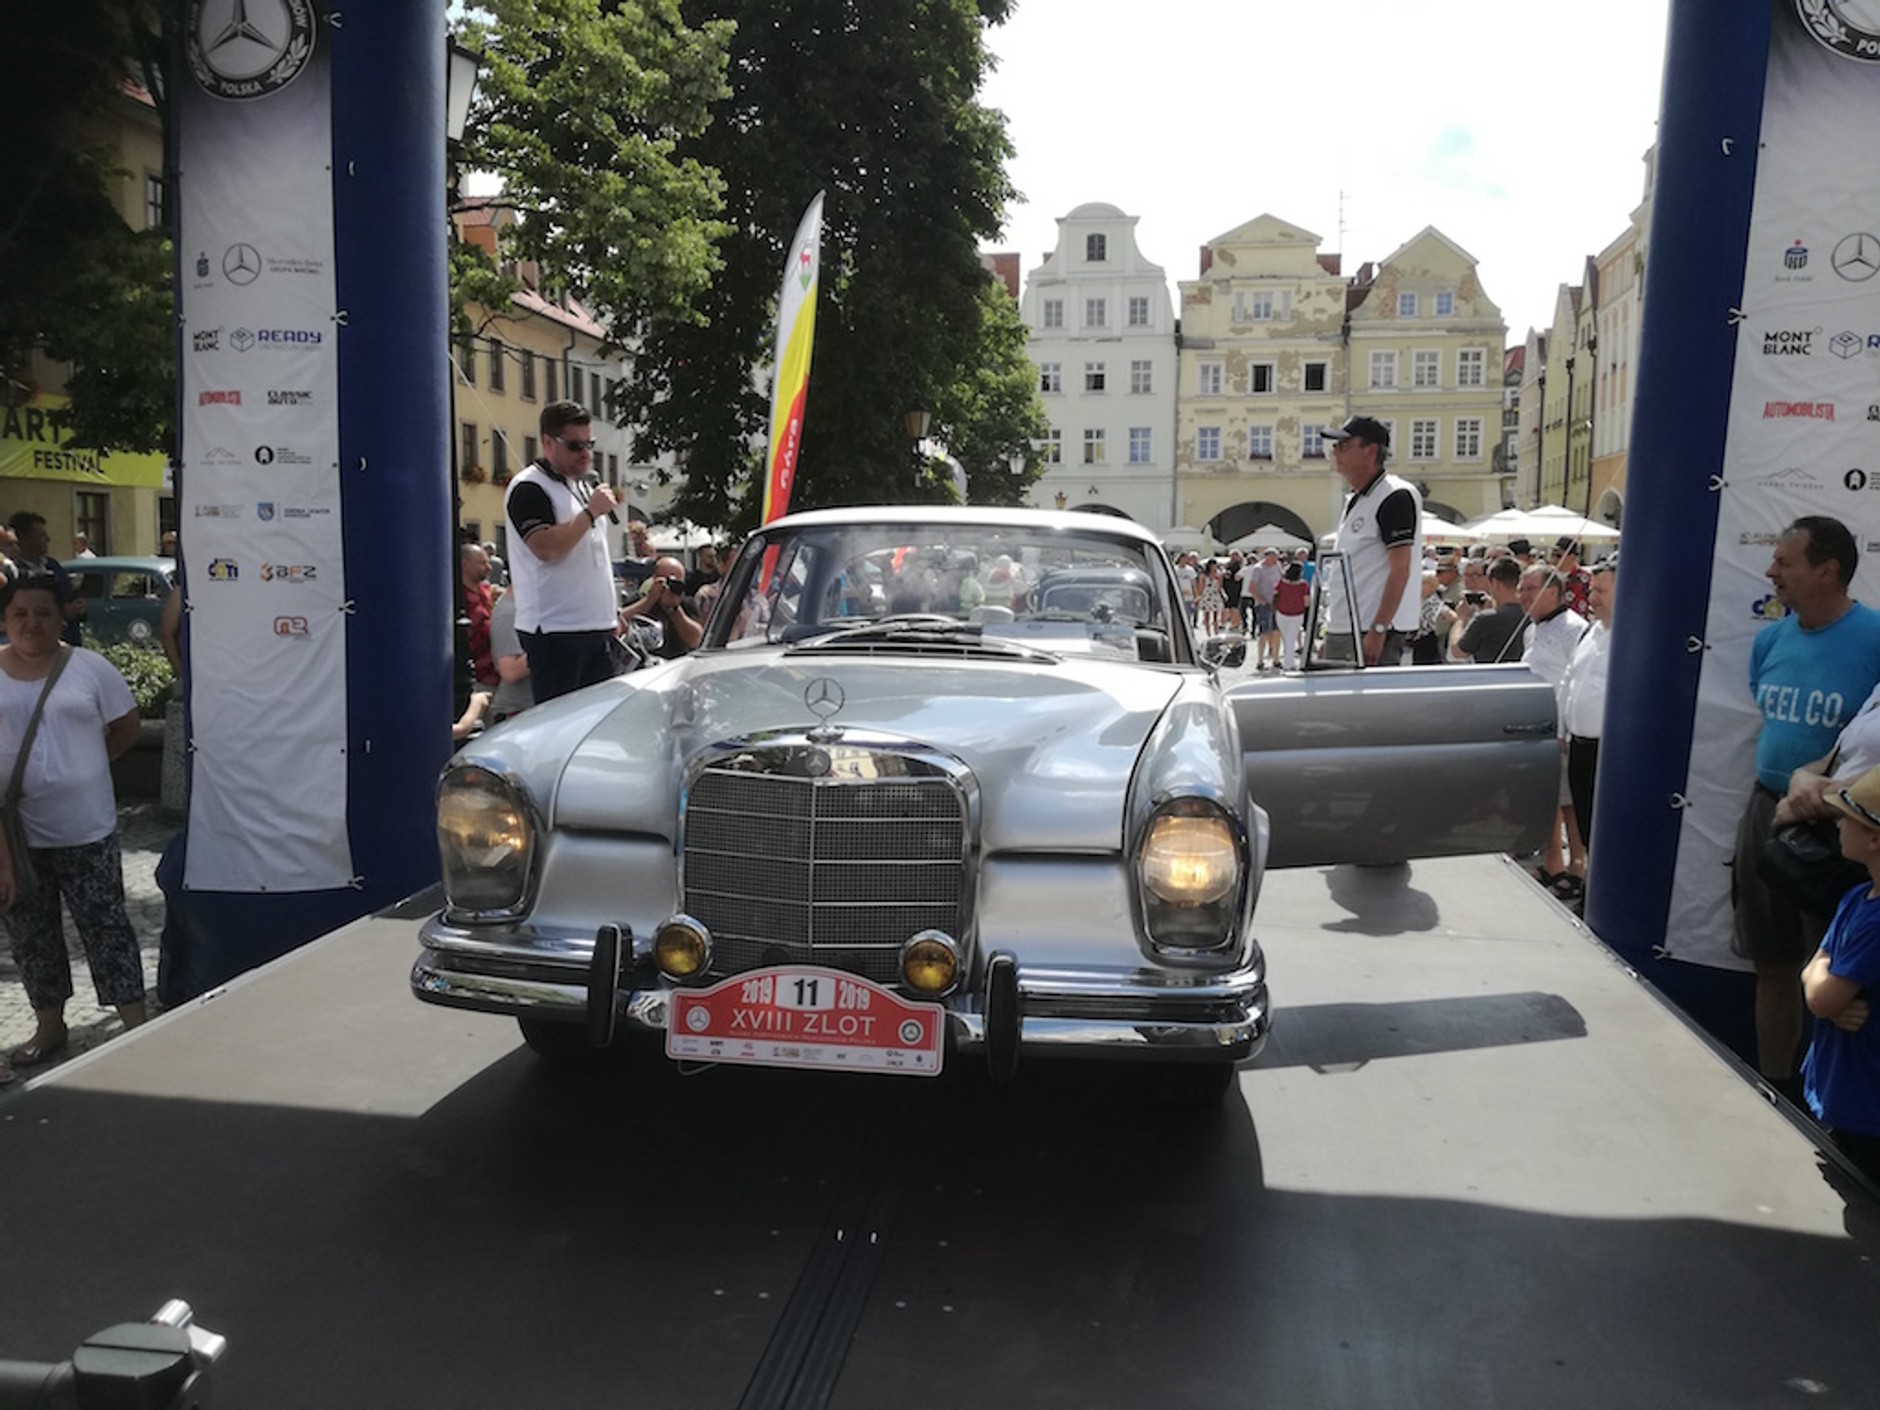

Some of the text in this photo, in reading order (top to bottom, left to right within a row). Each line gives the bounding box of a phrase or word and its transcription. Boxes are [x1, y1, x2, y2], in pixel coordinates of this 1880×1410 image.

[220, 81, 262, 95] POLSKA
[258, 330, 321, 344] READY
[1764, 331, 1812, 342] MONT
[1763, 344, 1812, 355] BLANC
[34, 450, 105, 474] FESTIVAL
[741, 976, 871, 1011] 2019 11 2019
[730, 1008, 877, 1037] XVIII ZLOT
